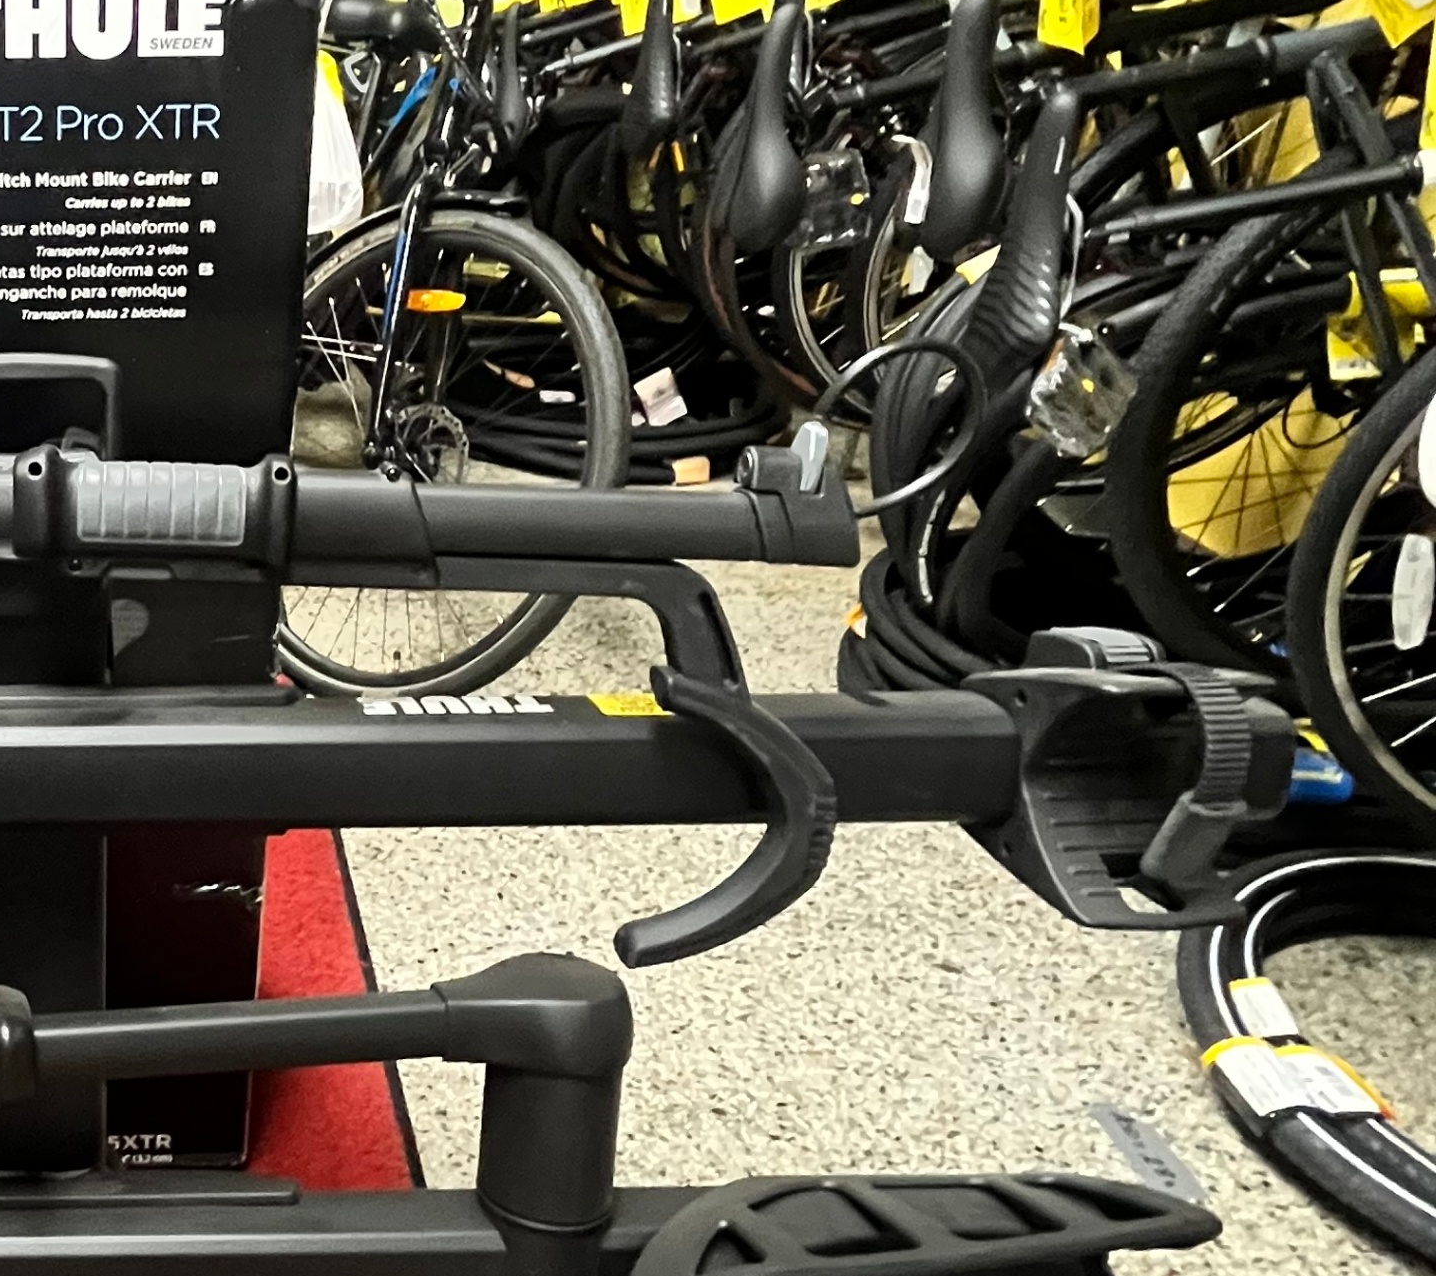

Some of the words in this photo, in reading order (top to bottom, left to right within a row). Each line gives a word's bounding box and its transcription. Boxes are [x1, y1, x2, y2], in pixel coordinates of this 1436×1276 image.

[149, 36, 214, 51] SWEDEN
[56, 105, 125, 141] Pro
[135, 103, 222, 140] XTR
[35, 171, 89, 188] Mount
[92, 171, 130, 187] Bike
[133, 169, 192, 187] Carrier
[65, 196, 108, 210] Carries
[110, 198, 128, 211] up
[130, 196, 145, 209] to
[146, 195, 156, 208] 2
[0, 223, 26, 237] sur
[29, 221, 97, 238] attelage
[100, 219, 190, 238] plateforme
[36, 245, 100, 259] Transporte
[146, 244, 156, 256] 2
[30, 264, 63, 281] tipo
[66, 262, 154, 281] plataforma
[157, 264, 189, 277] con
[71, 286, 108, 302] para
[111, 282, 189, 300] remolque
[119, 307, 130, 319] 2
[357, 695, 554, 716] THULE
